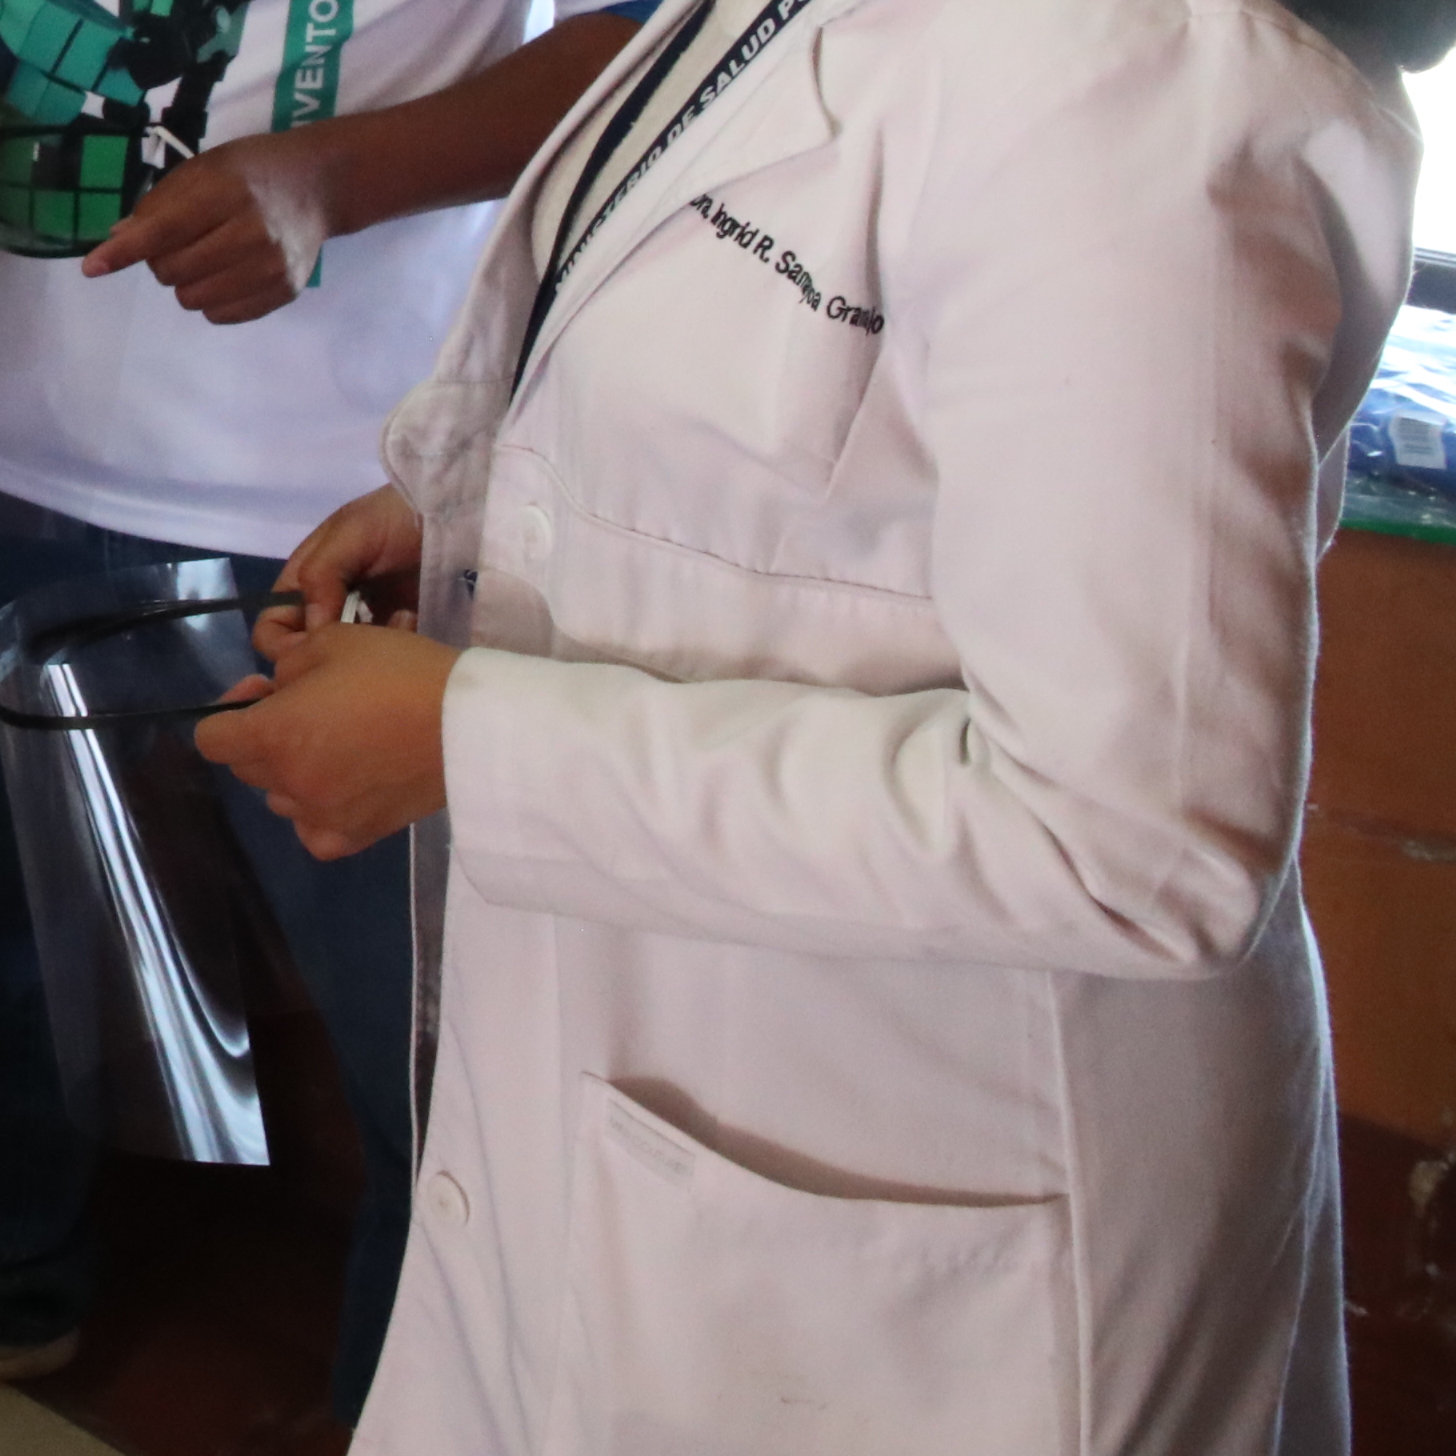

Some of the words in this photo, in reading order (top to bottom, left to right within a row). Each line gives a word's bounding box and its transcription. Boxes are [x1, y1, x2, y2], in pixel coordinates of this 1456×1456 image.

[666, 105, 696, 146] DE
[699, 17, 776, 104] SALUD
[710, 203, 760, 249] Ingrid
[753, 234, 775, 264] R.
